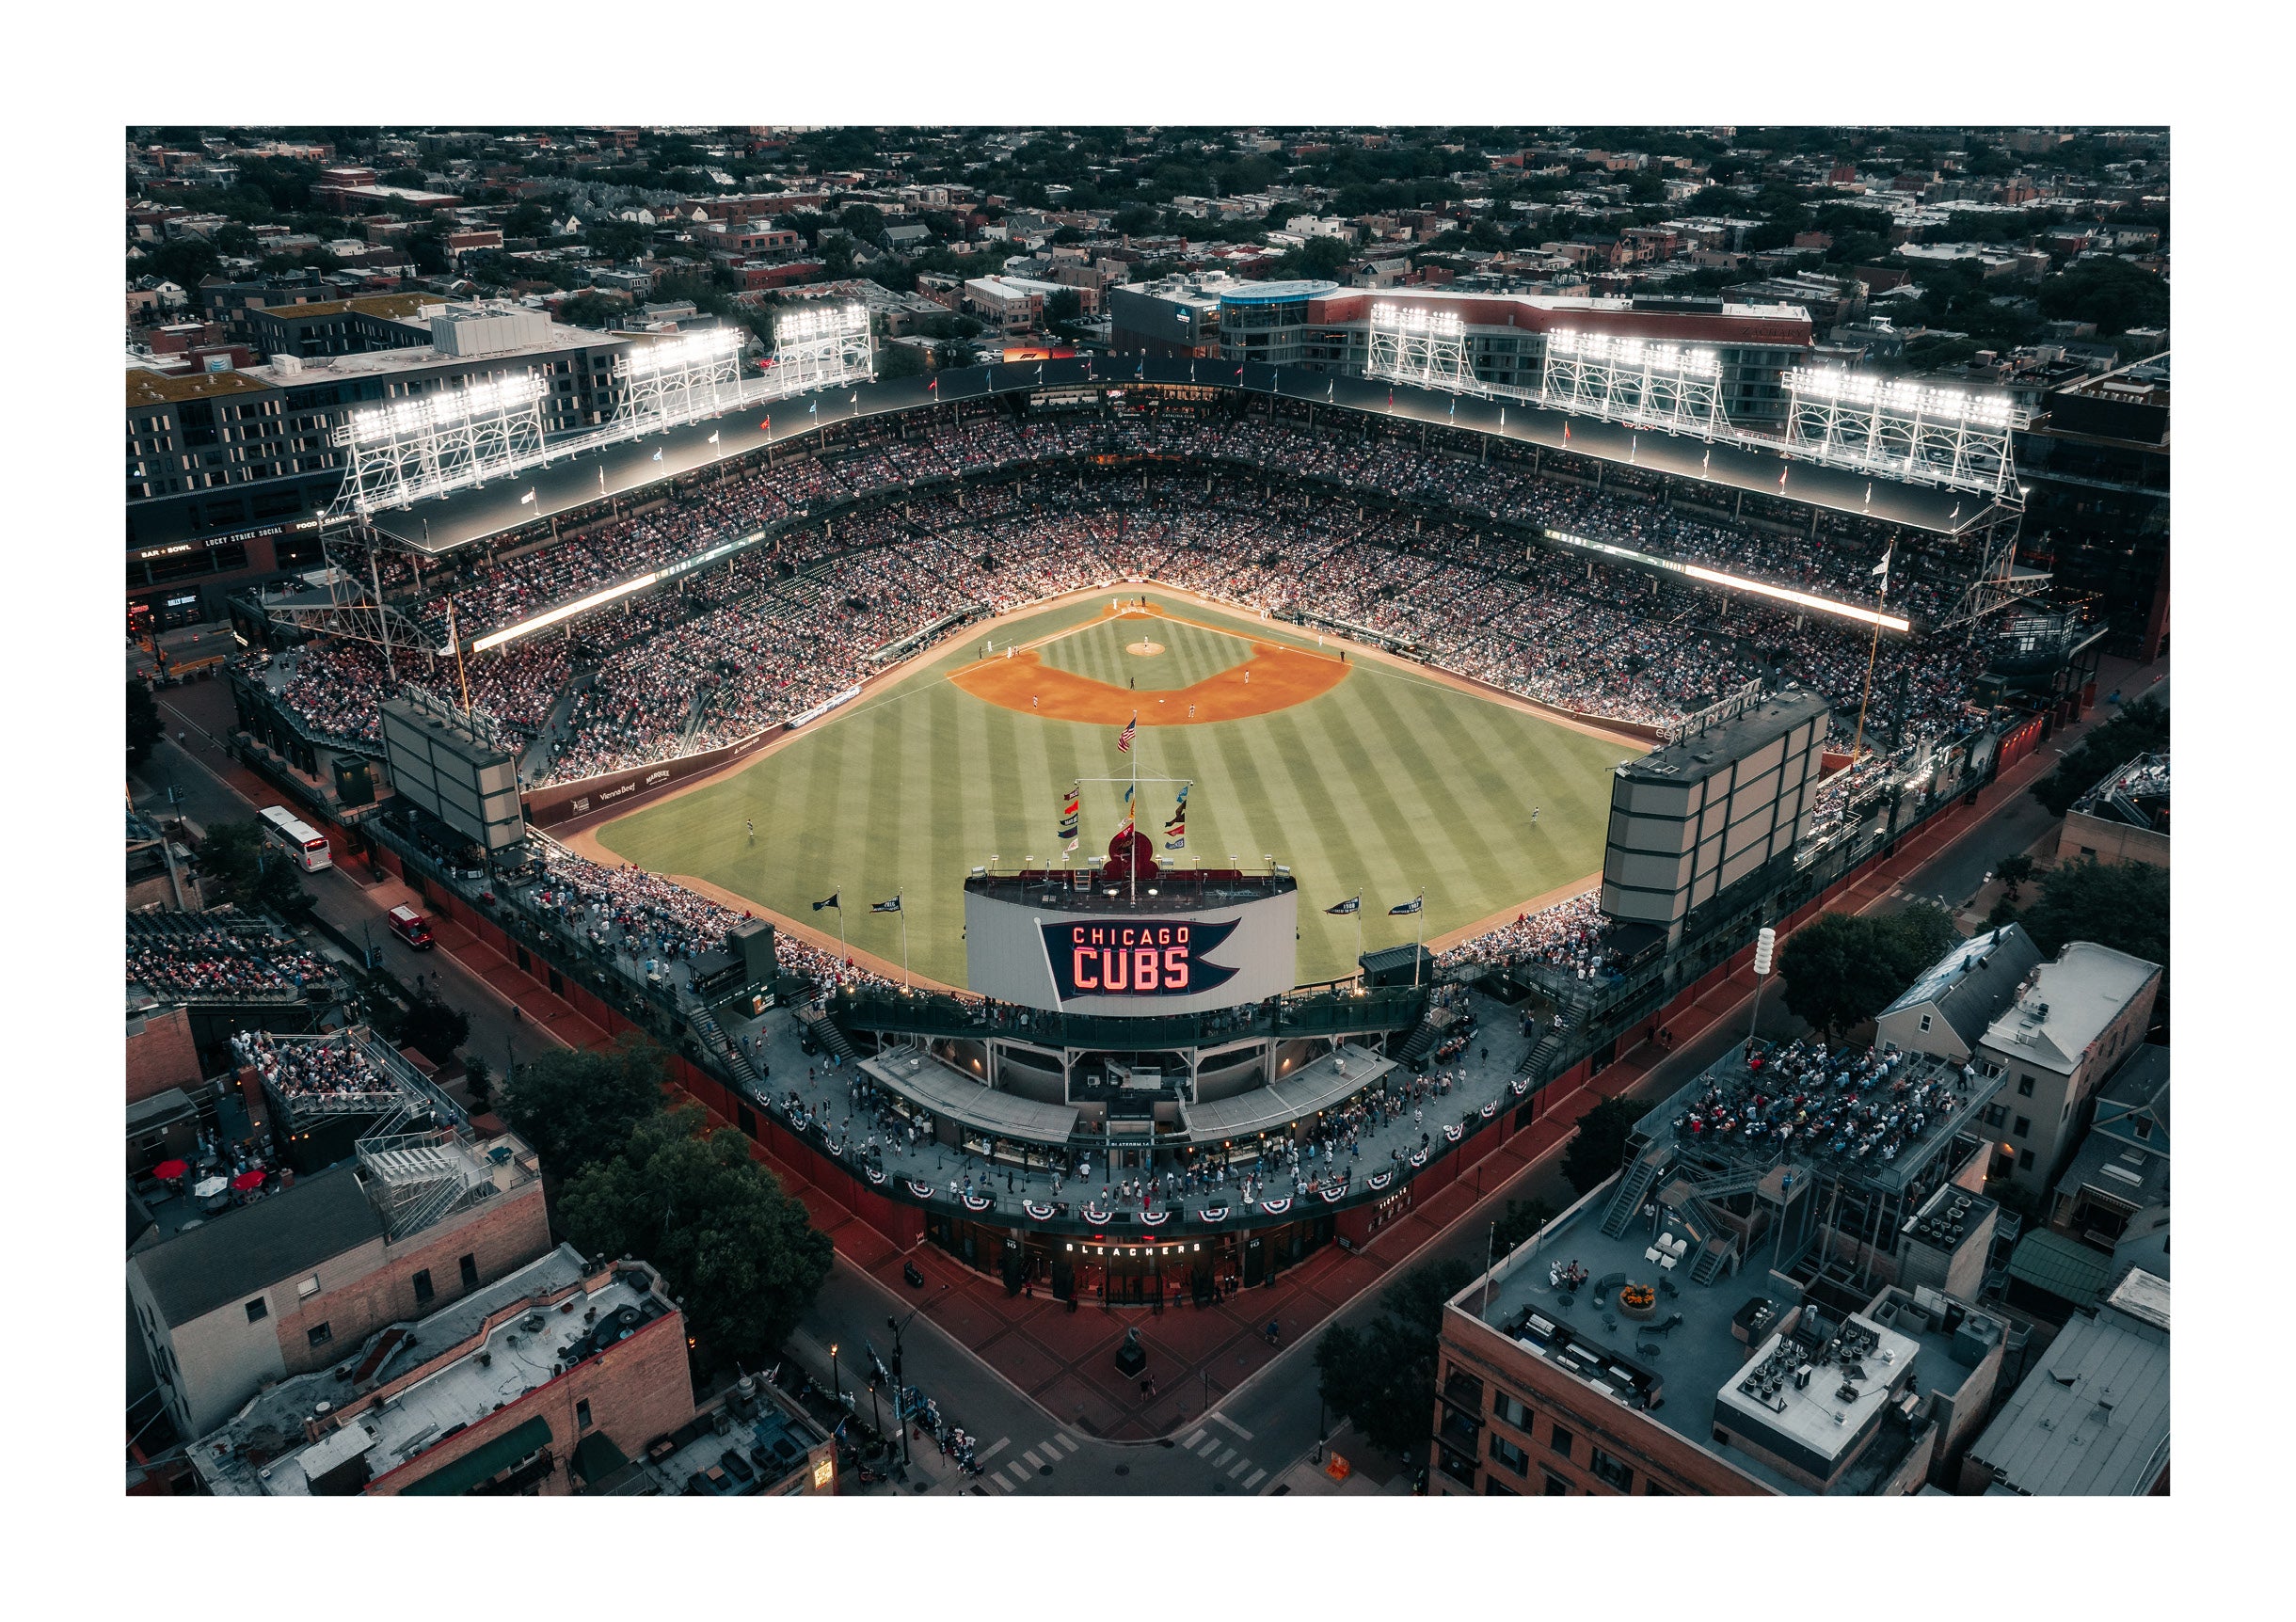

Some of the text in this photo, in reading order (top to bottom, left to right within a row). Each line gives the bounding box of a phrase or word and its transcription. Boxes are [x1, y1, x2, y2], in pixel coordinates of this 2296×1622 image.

[1741, 326, 1803, 337] ZACHARY
[295, 521, 318, 530] FOOD
[205, 527, 283, 547] LUCKY STRIKE SOCIAL
[141, 544, 192, 558] BAR BOWL
[646, 771, 670, 784] MARQUEE
[599, 783, 635, 801] Vienna Beef
[1073, 927, 1188, 946] CHICAGO
[1073, 946, 1188, 990] CUBS
[1066, 1243, 1200, 1256] BLEACHERS
